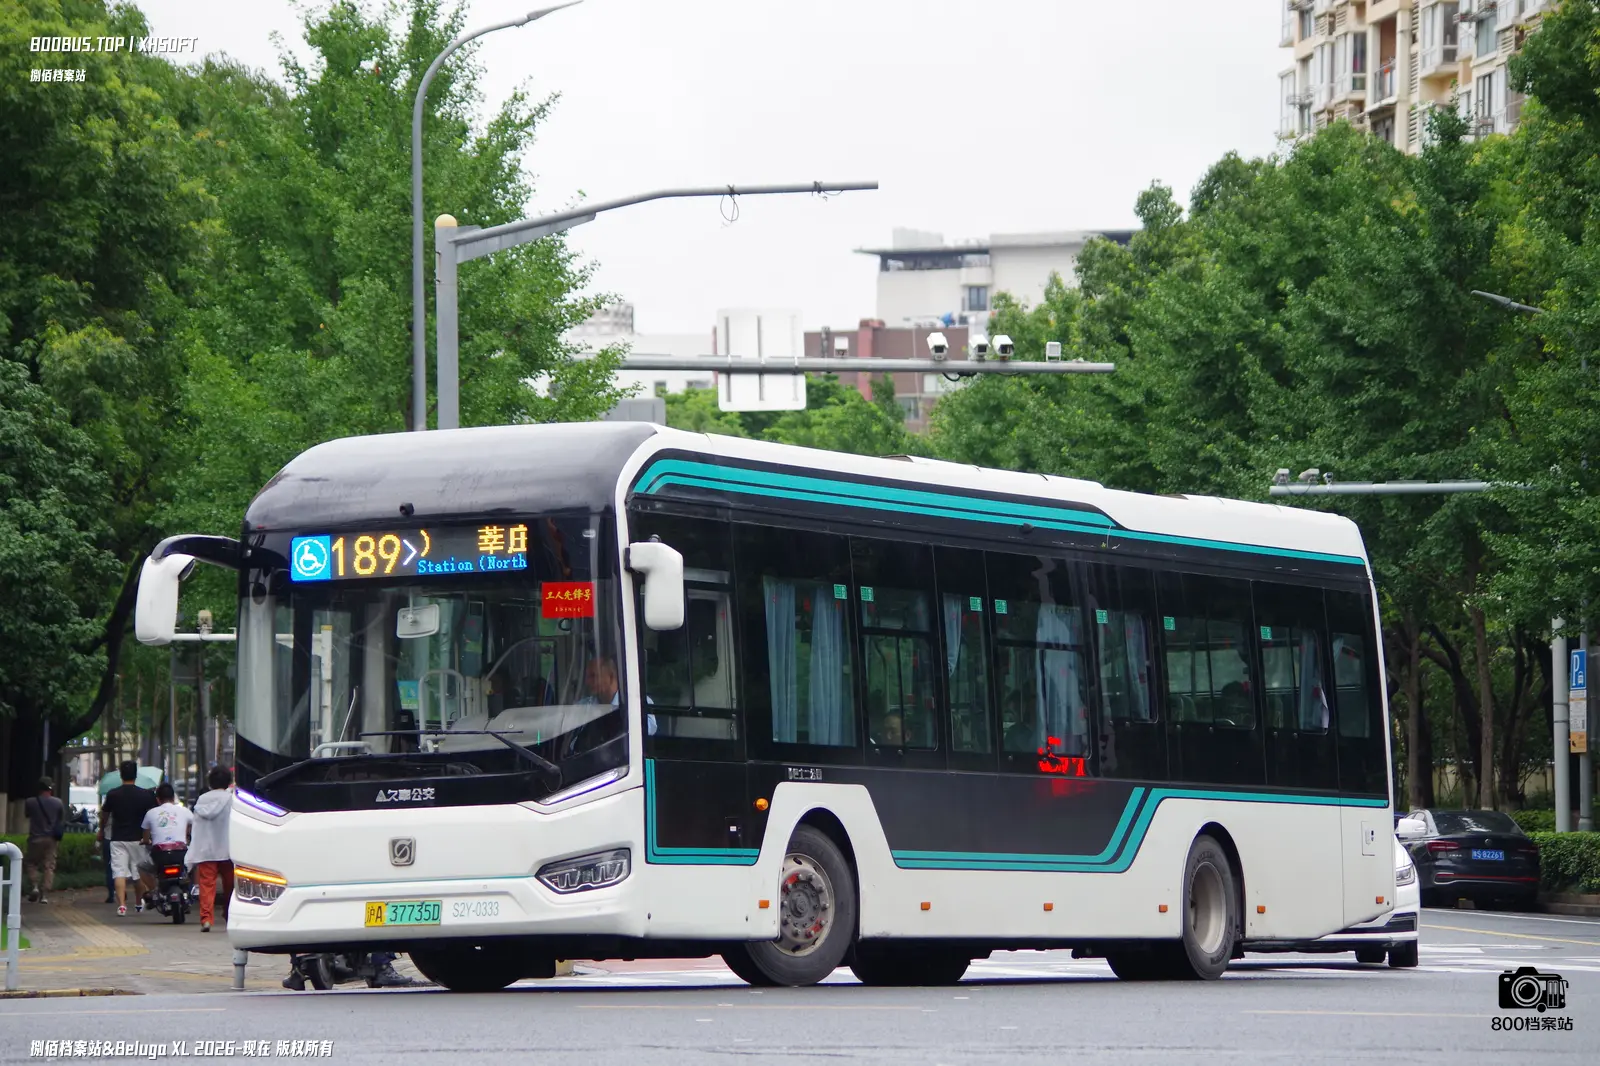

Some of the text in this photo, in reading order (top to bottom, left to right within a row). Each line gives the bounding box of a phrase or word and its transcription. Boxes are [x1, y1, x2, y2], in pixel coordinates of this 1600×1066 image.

[332, 534, 401, 576] 189
[417, 553, 527, 574] Station (North
[545, 588, 591, 601] 工人先锋号
[1572, 654, 1580, 686] P
[452, 901, 500, 918] S2Y-0333
